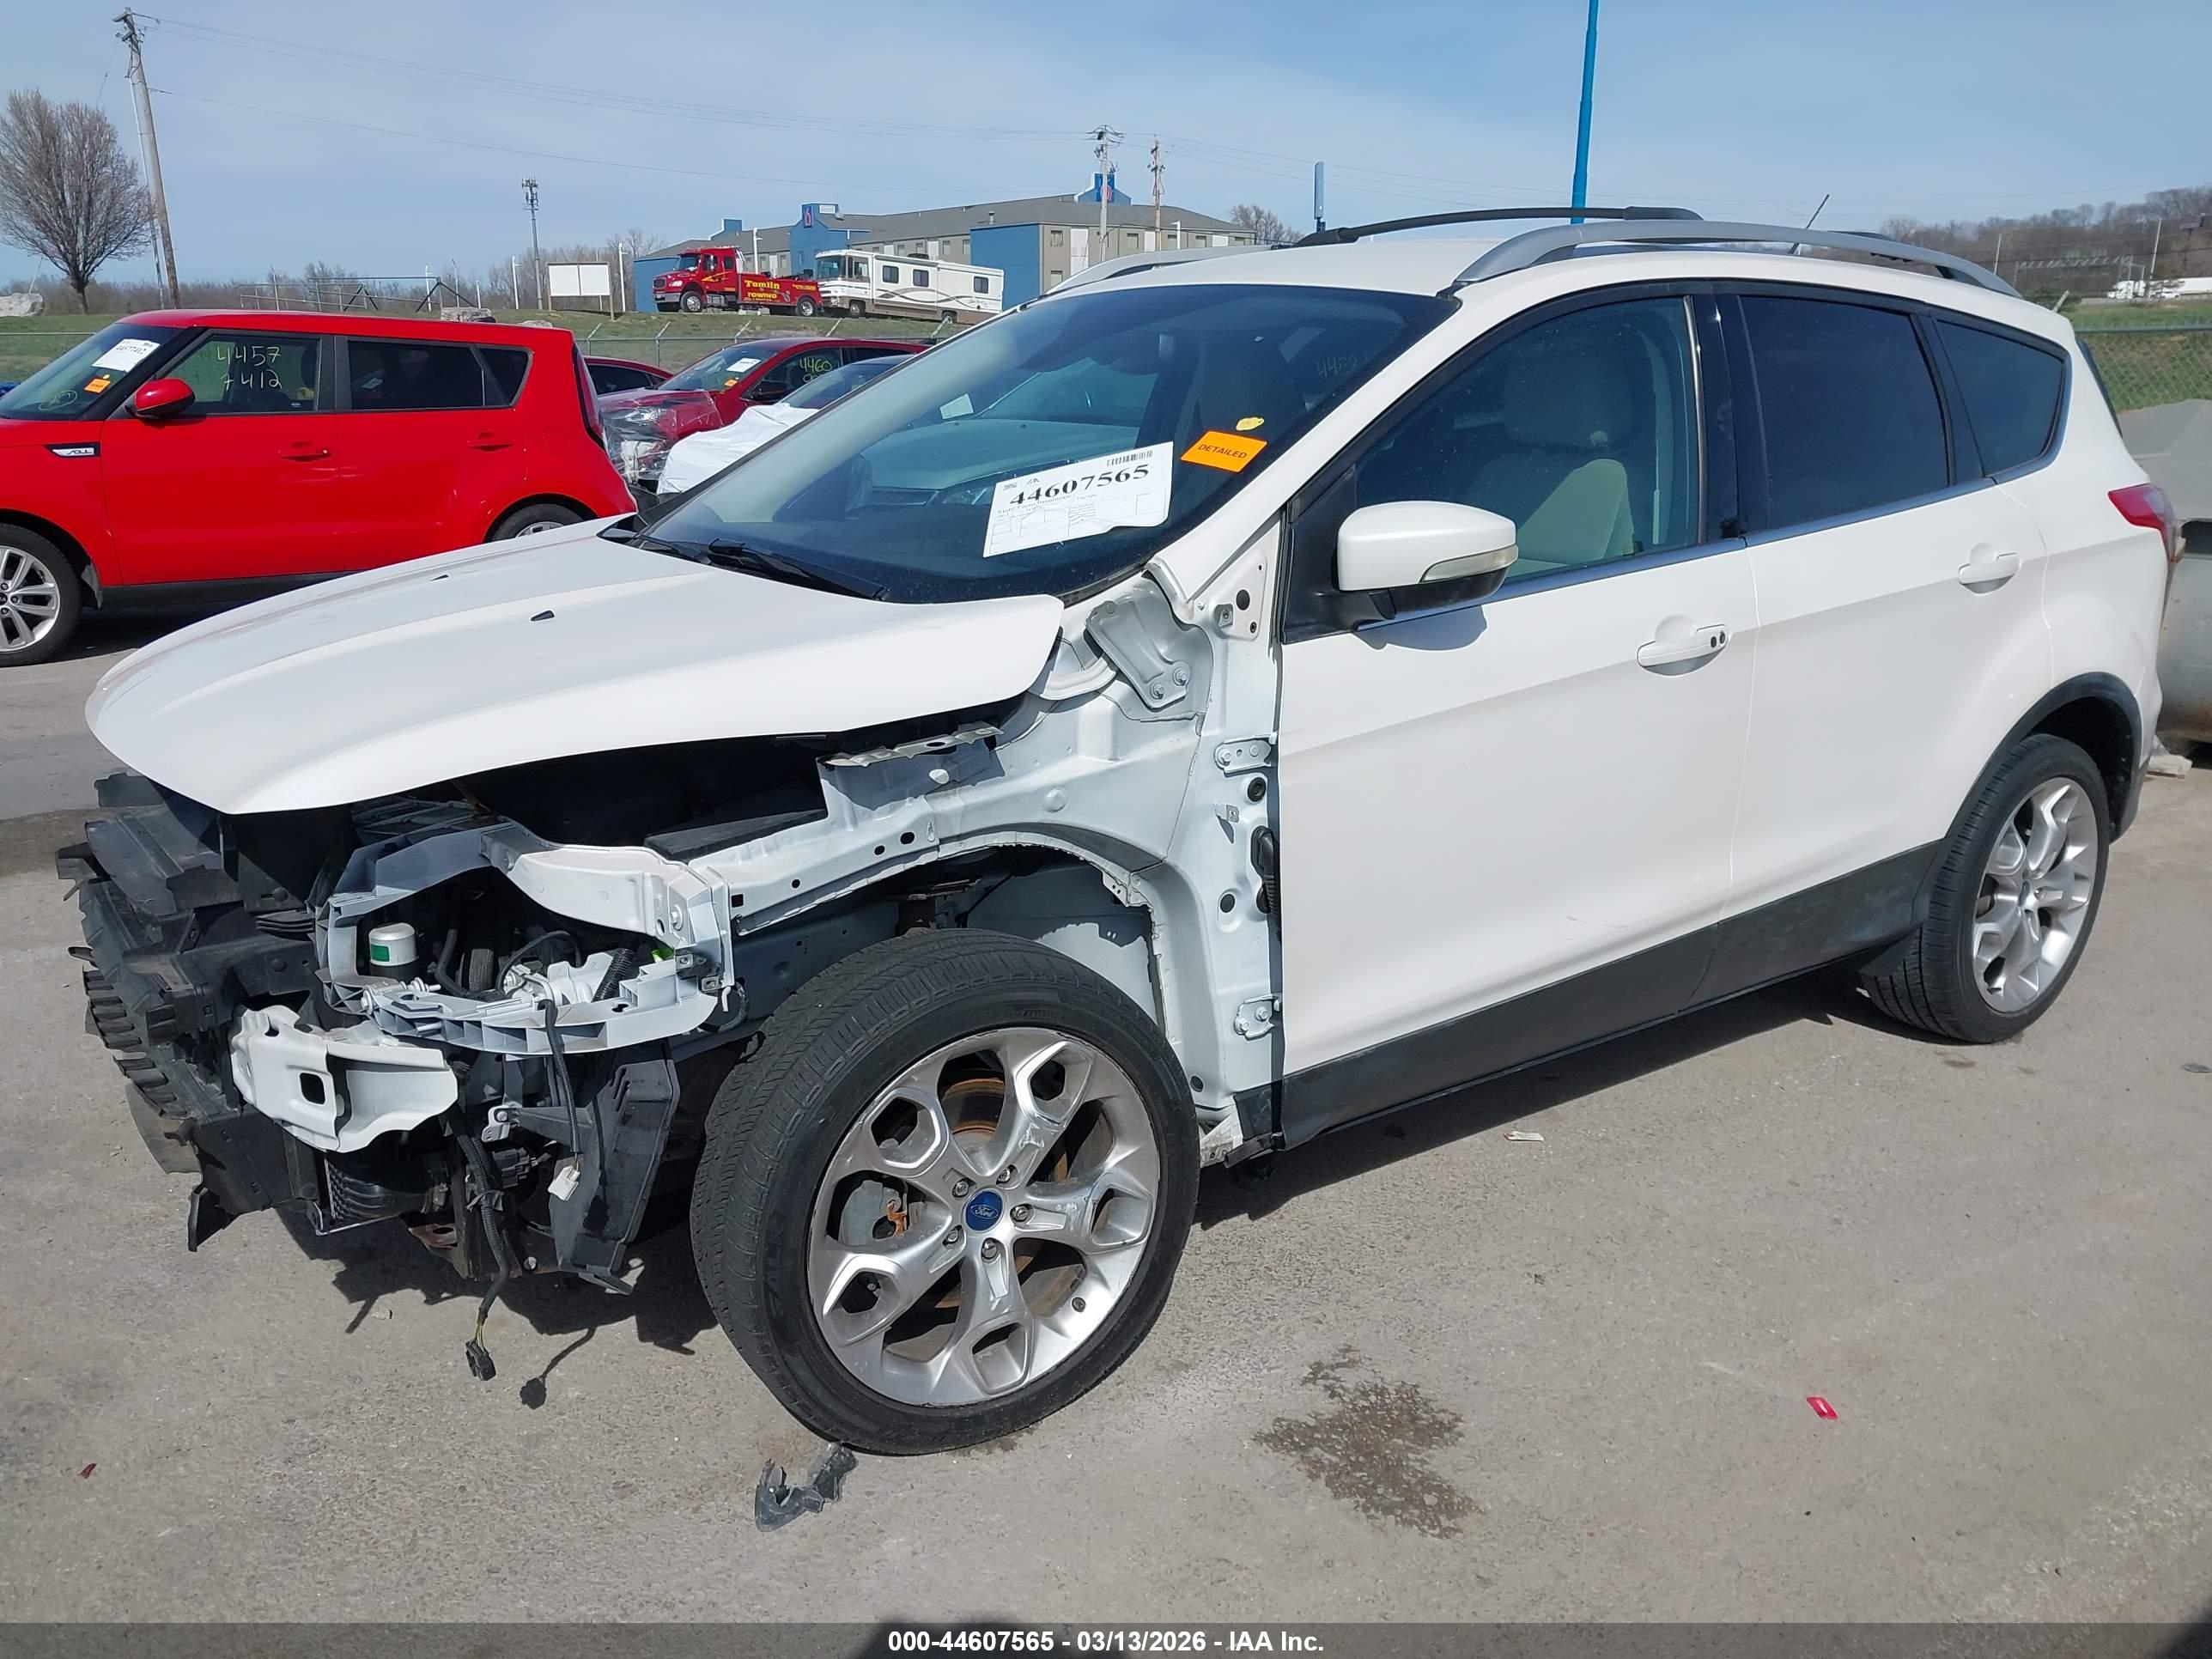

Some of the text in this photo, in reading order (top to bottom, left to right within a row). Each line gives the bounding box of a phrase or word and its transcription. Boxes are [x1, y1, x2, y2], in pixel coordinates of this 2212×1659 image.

[217, 345, 282, 367] 4457
[799, 357, 832, 373] 4460
[220, 368, 283, 392] 7412
[1198, 444, 1248, 459] DETAILED
[1010, 463, 1150, 505] 44607565
[975, 1206, 994, 1217] Ford
